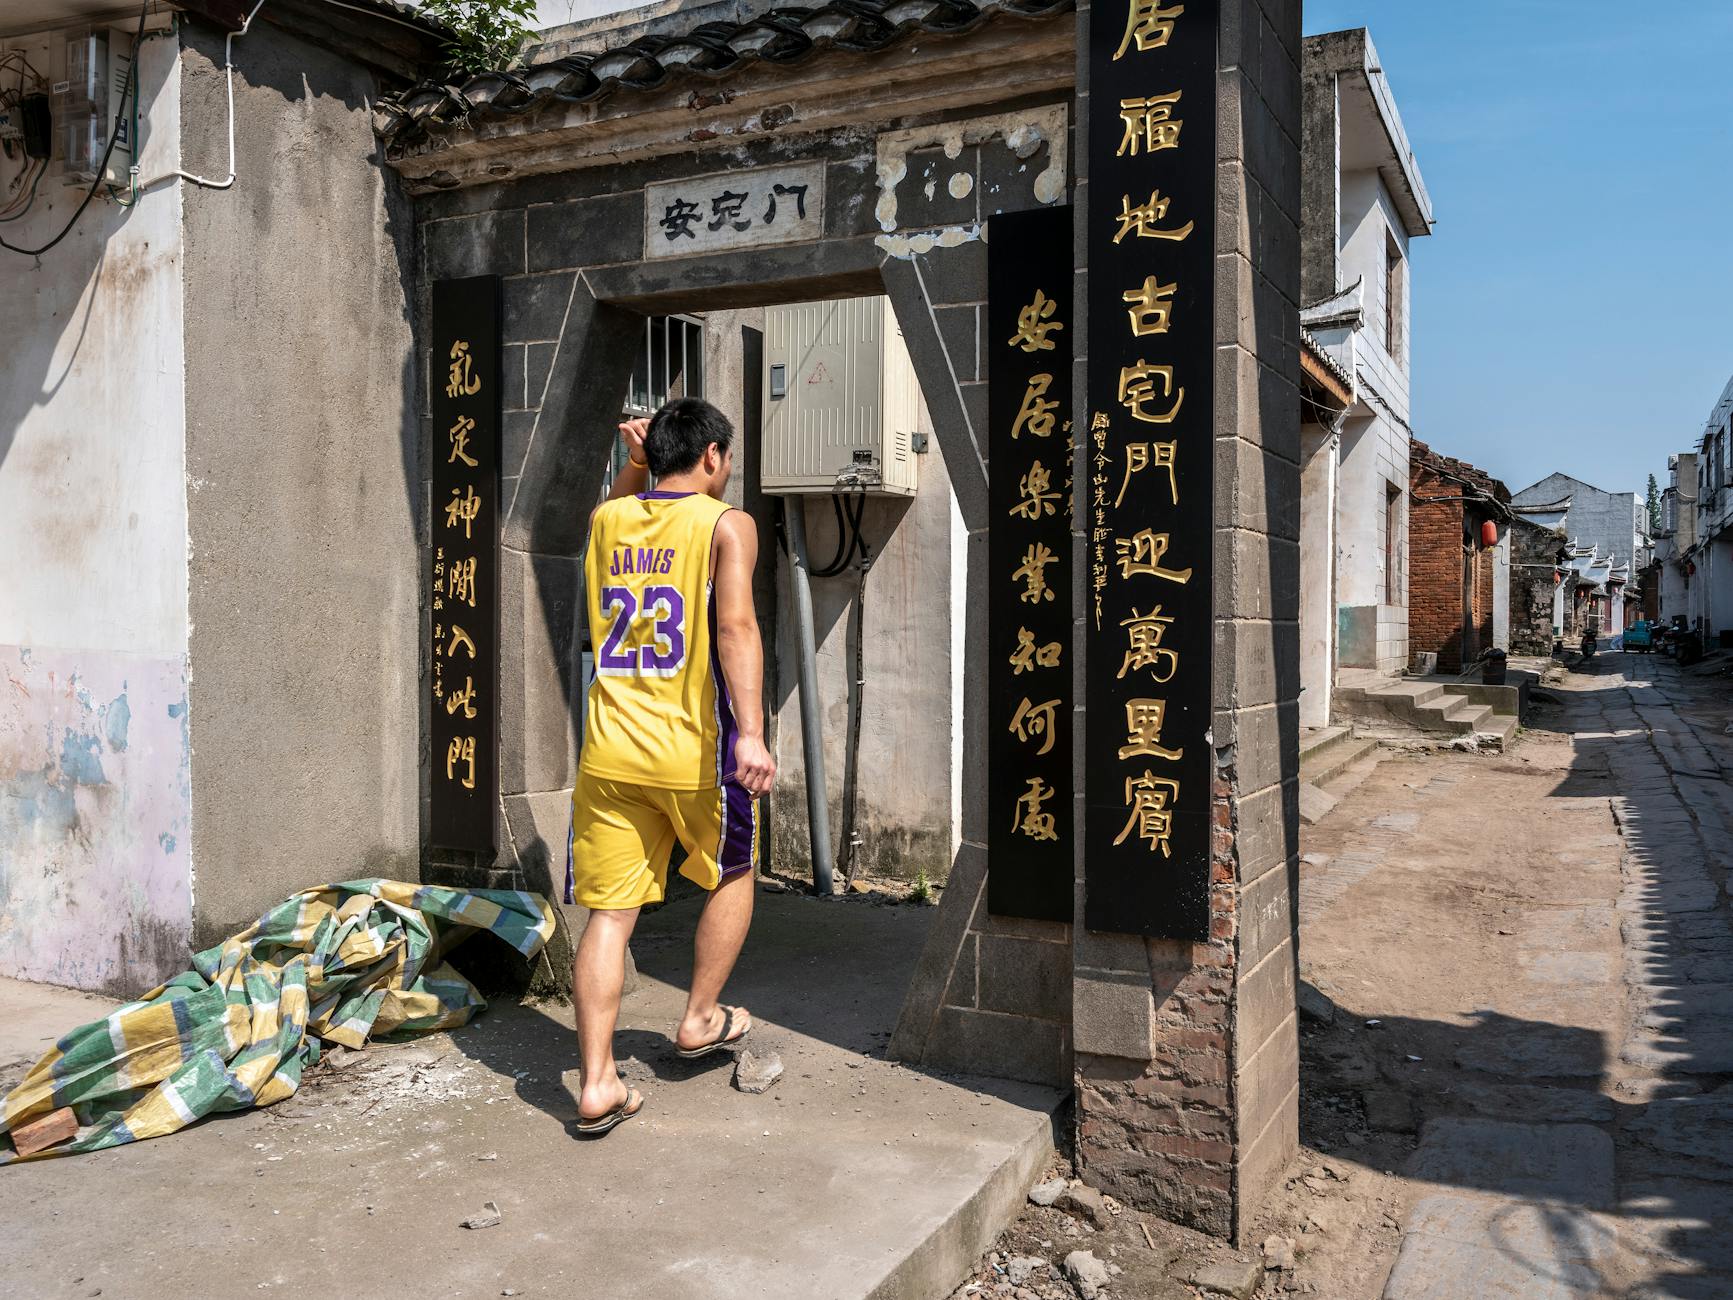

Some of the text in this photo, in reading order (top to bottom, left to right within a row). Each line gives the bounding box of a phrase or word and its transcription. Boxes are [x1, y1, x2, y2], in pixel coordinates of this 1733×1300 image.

[659, 183, 808, 241] 安定门
[609, 548, 675, 576] JAMES
[597, 584, 686, 678] 23
